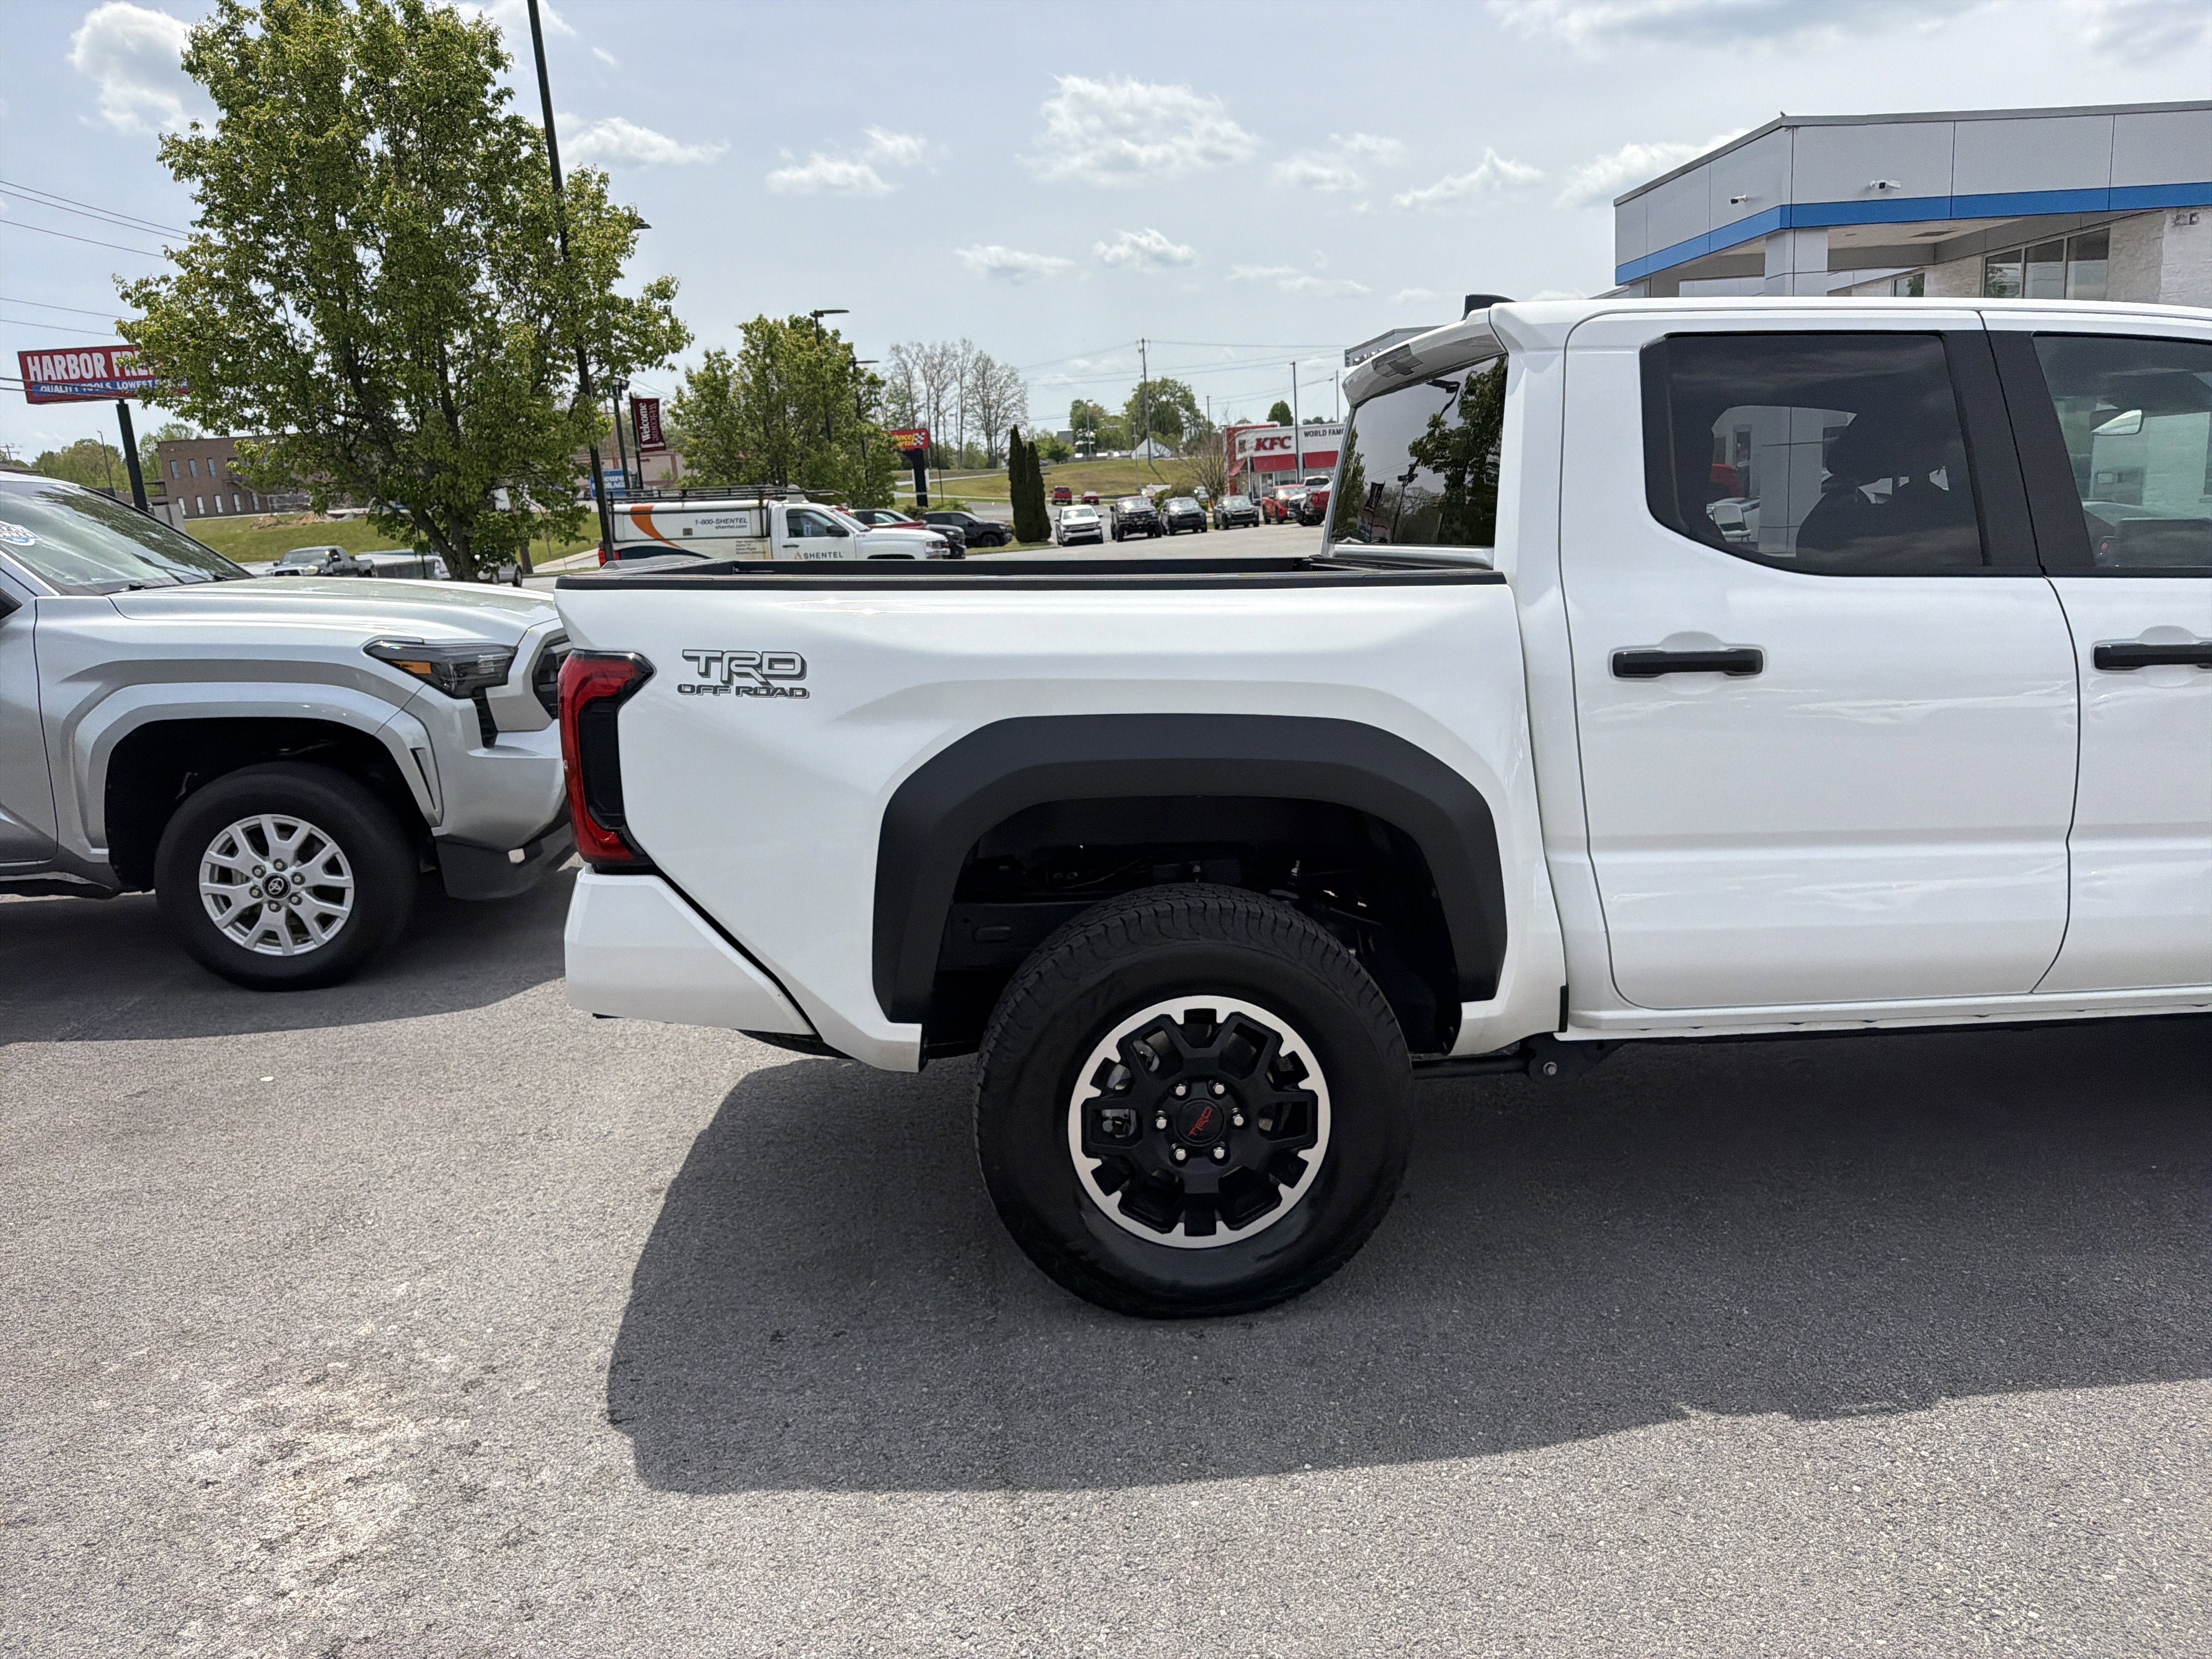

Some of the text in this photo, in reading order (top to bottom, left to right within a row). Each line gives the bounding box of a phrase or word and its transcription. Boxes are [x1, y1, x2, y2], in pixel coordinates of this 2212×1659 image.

[26, 352, 108, 381] HARBOR
[116, 380, 153, 390] LOWEST
[639, 402, 651, 442] Welcome
[1255, 436, 1293, 451] KFC
[1304, 430, 1327, 438] WORLD
[682, 649, 807, 687] TRD
[677, 684, 810, 699] OFF ROAD
[1187, 1106, 1212, 1137] TRD
